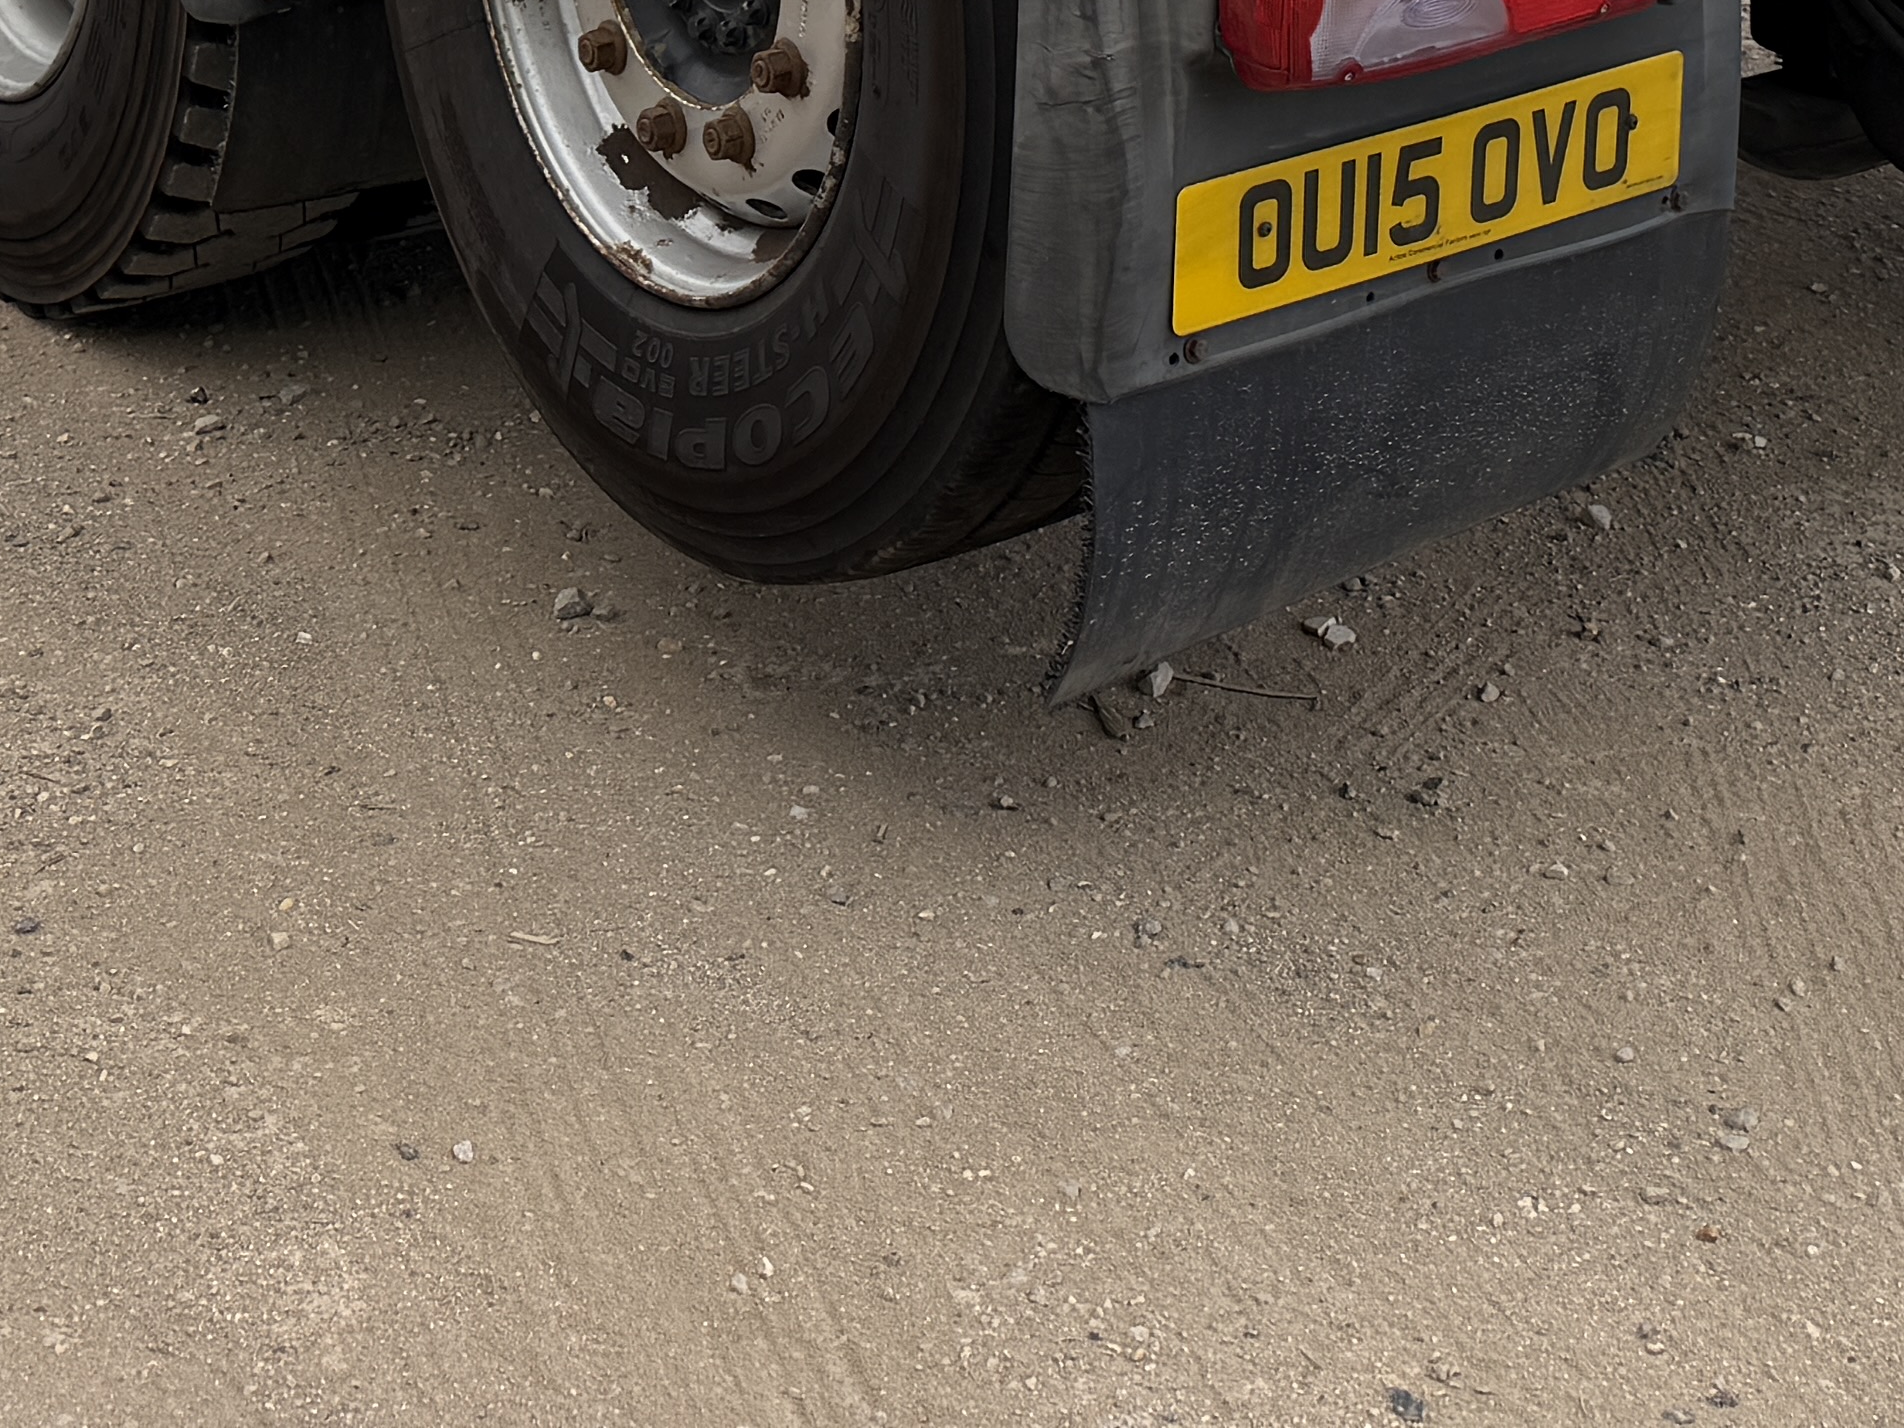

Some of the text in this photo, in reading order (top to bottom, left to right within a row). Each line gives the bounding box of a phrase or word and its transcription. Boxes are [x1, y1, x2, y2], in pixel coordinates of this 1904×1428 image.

[1238, 87, 1631, 290] OU15 OVO
[631, 329, 674, 369] 002
